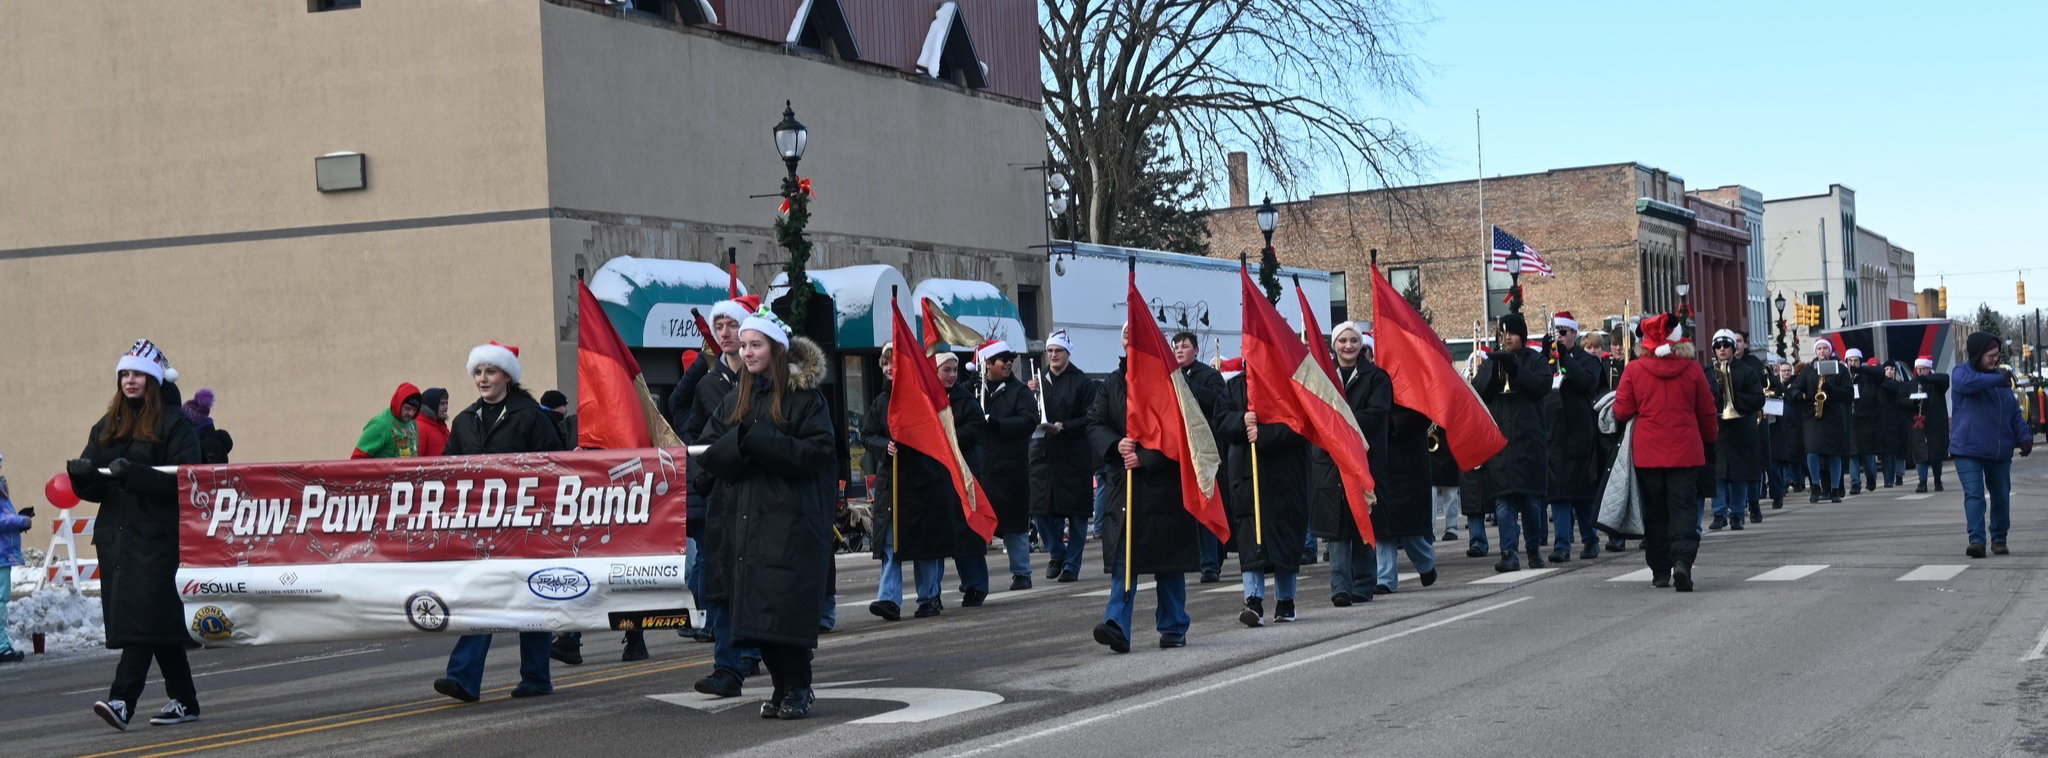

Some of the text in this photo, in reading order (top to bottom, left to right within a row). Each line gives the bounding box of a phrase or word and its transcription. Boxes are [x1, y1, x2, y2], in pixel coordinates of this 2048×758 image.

[669, 318, 704, 338] VAPO
[207, 472, 656, 538] Paw Paw P.R.I.D.E. Band
[608, 563, 679, 585] PENNINGS
[198, 607, 222, 618] LIONS
[207, 619, 219, 631] L
[642, 615, 687, 628] WRAPS
